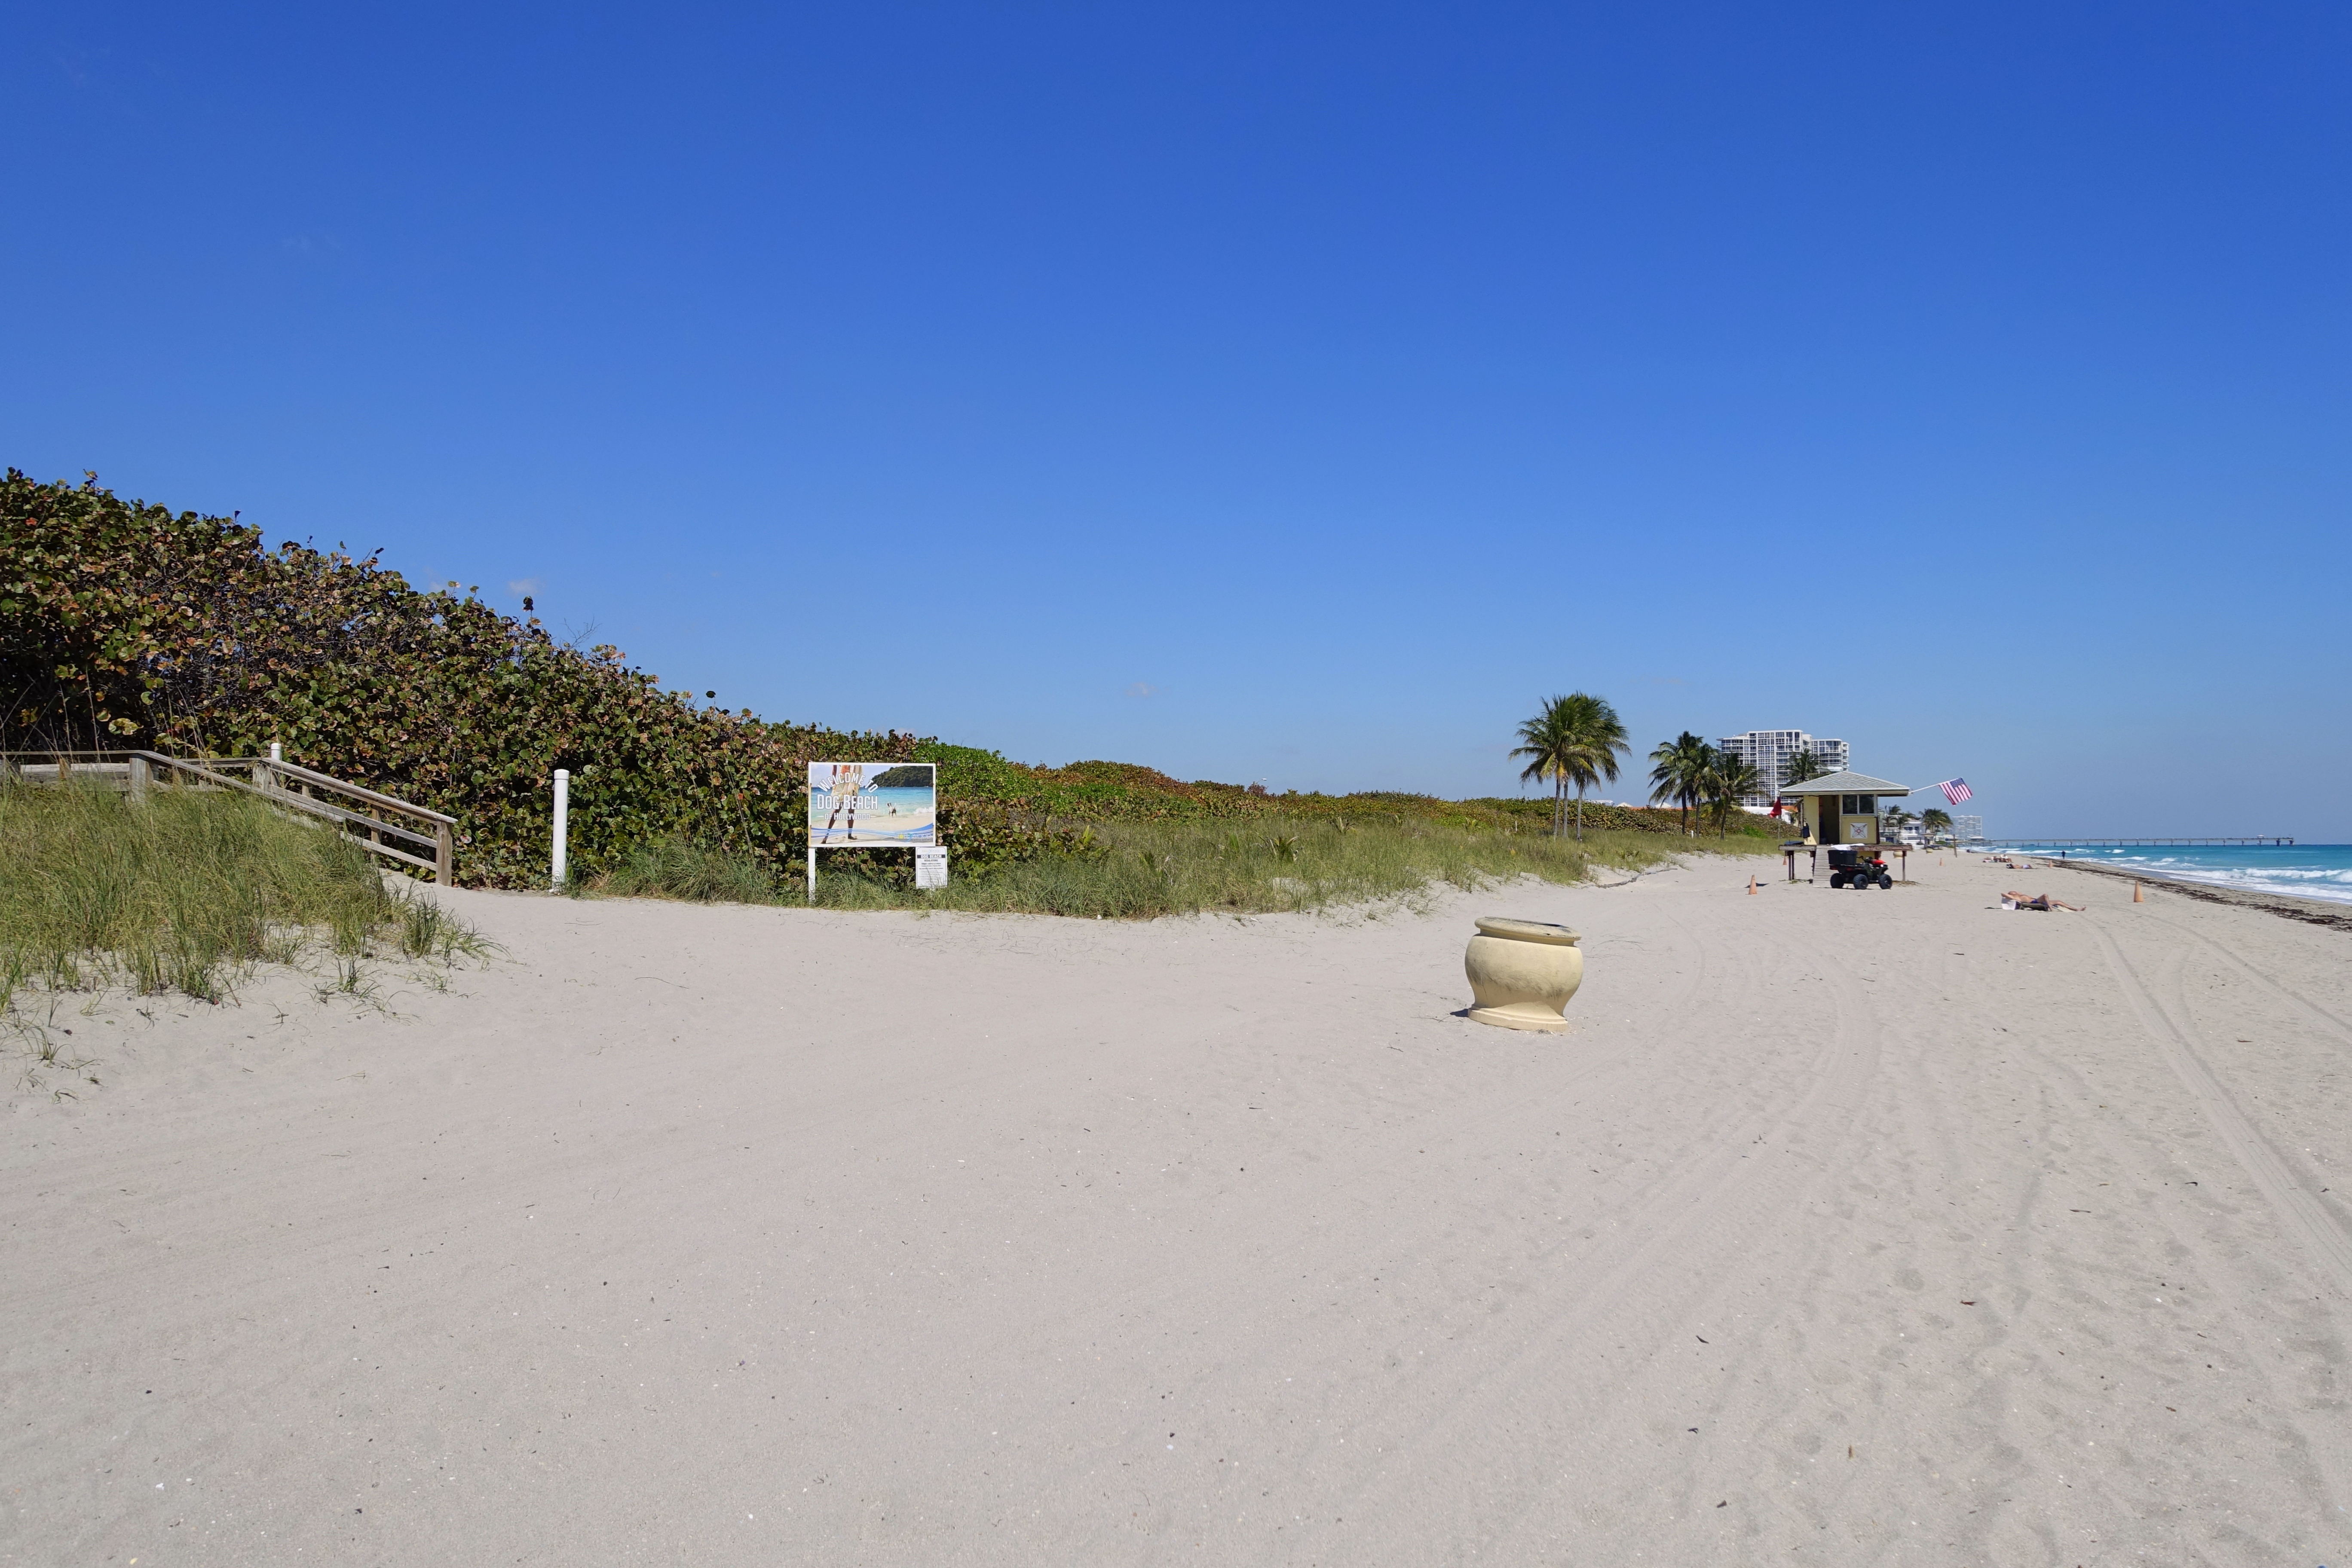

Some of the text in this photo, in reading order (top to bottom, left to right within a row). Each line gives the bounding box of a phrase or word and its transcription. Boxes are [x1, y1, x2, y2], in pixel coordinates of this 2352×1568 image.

[817, 772, 879, 793] WELCOME TO
[817, 794, 878, 809] DOG BEACH
